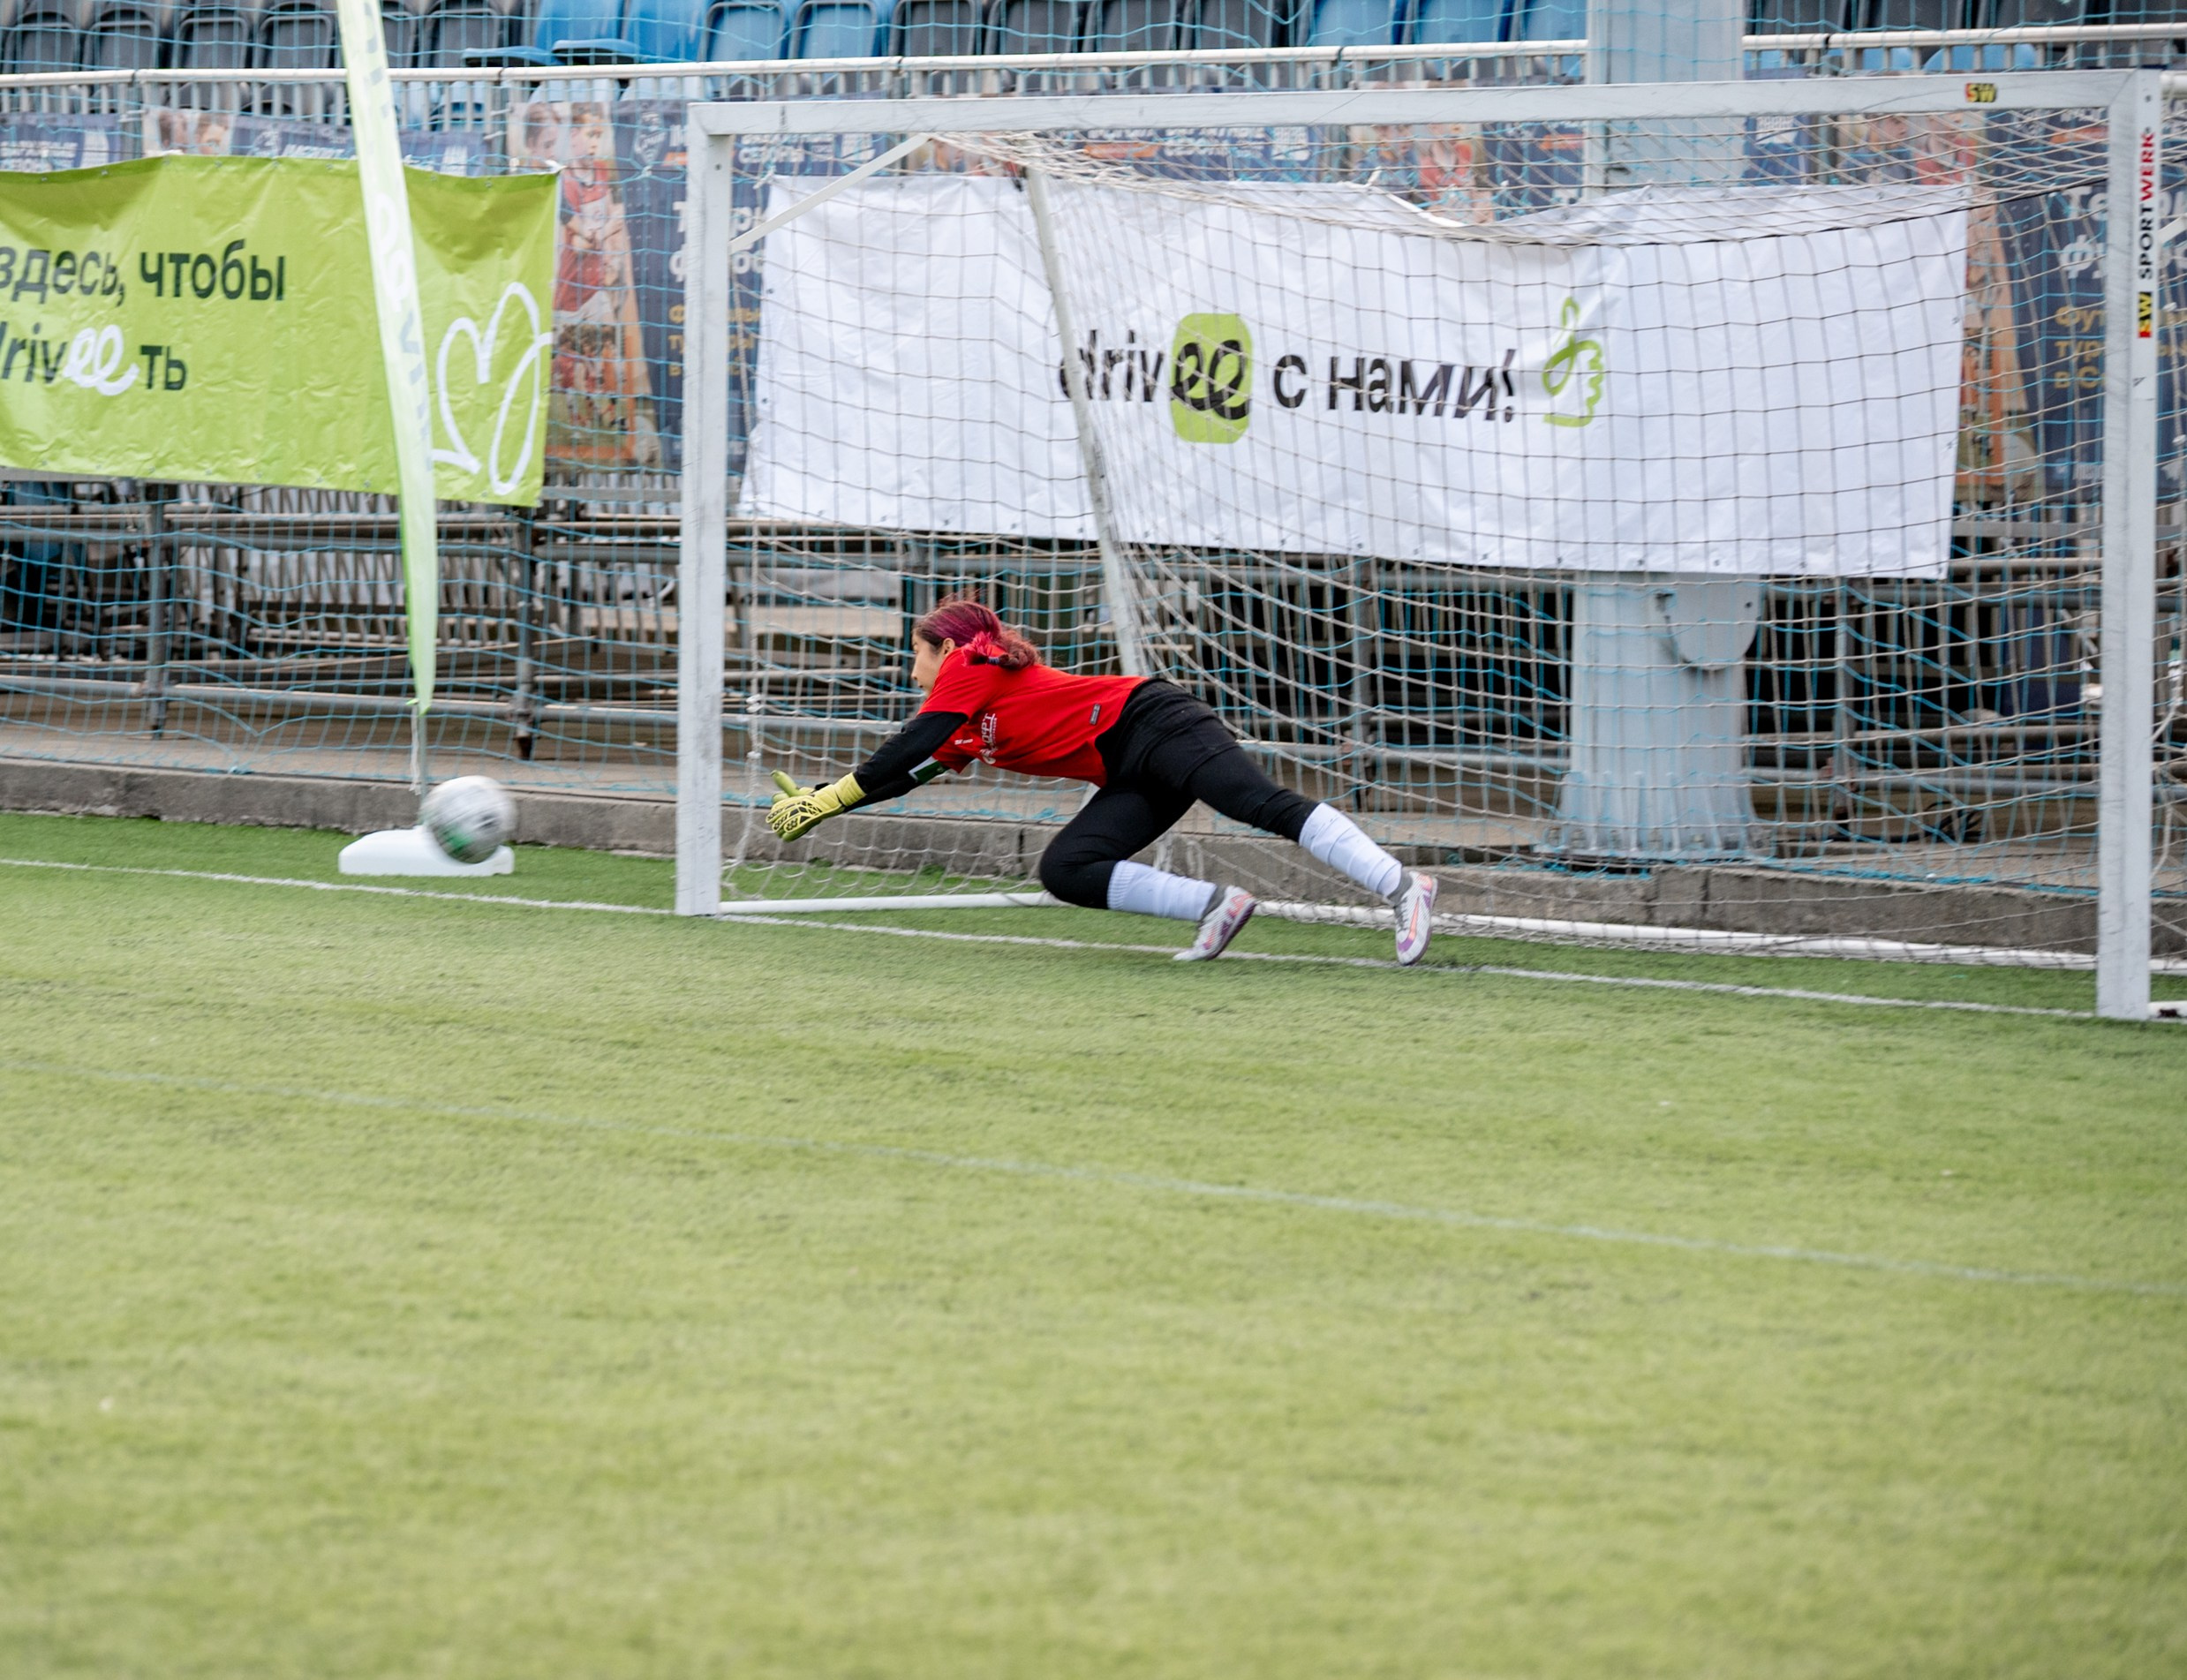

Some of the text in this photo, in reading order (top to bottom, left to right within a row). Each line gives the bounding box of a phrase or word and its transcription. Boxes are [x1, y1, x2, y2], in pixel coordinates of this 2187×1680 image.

[140, 238, 286, 301] чтобы
[1273, 354, 1307, 408] с
[1329, 349, 1516, 423] нами!
